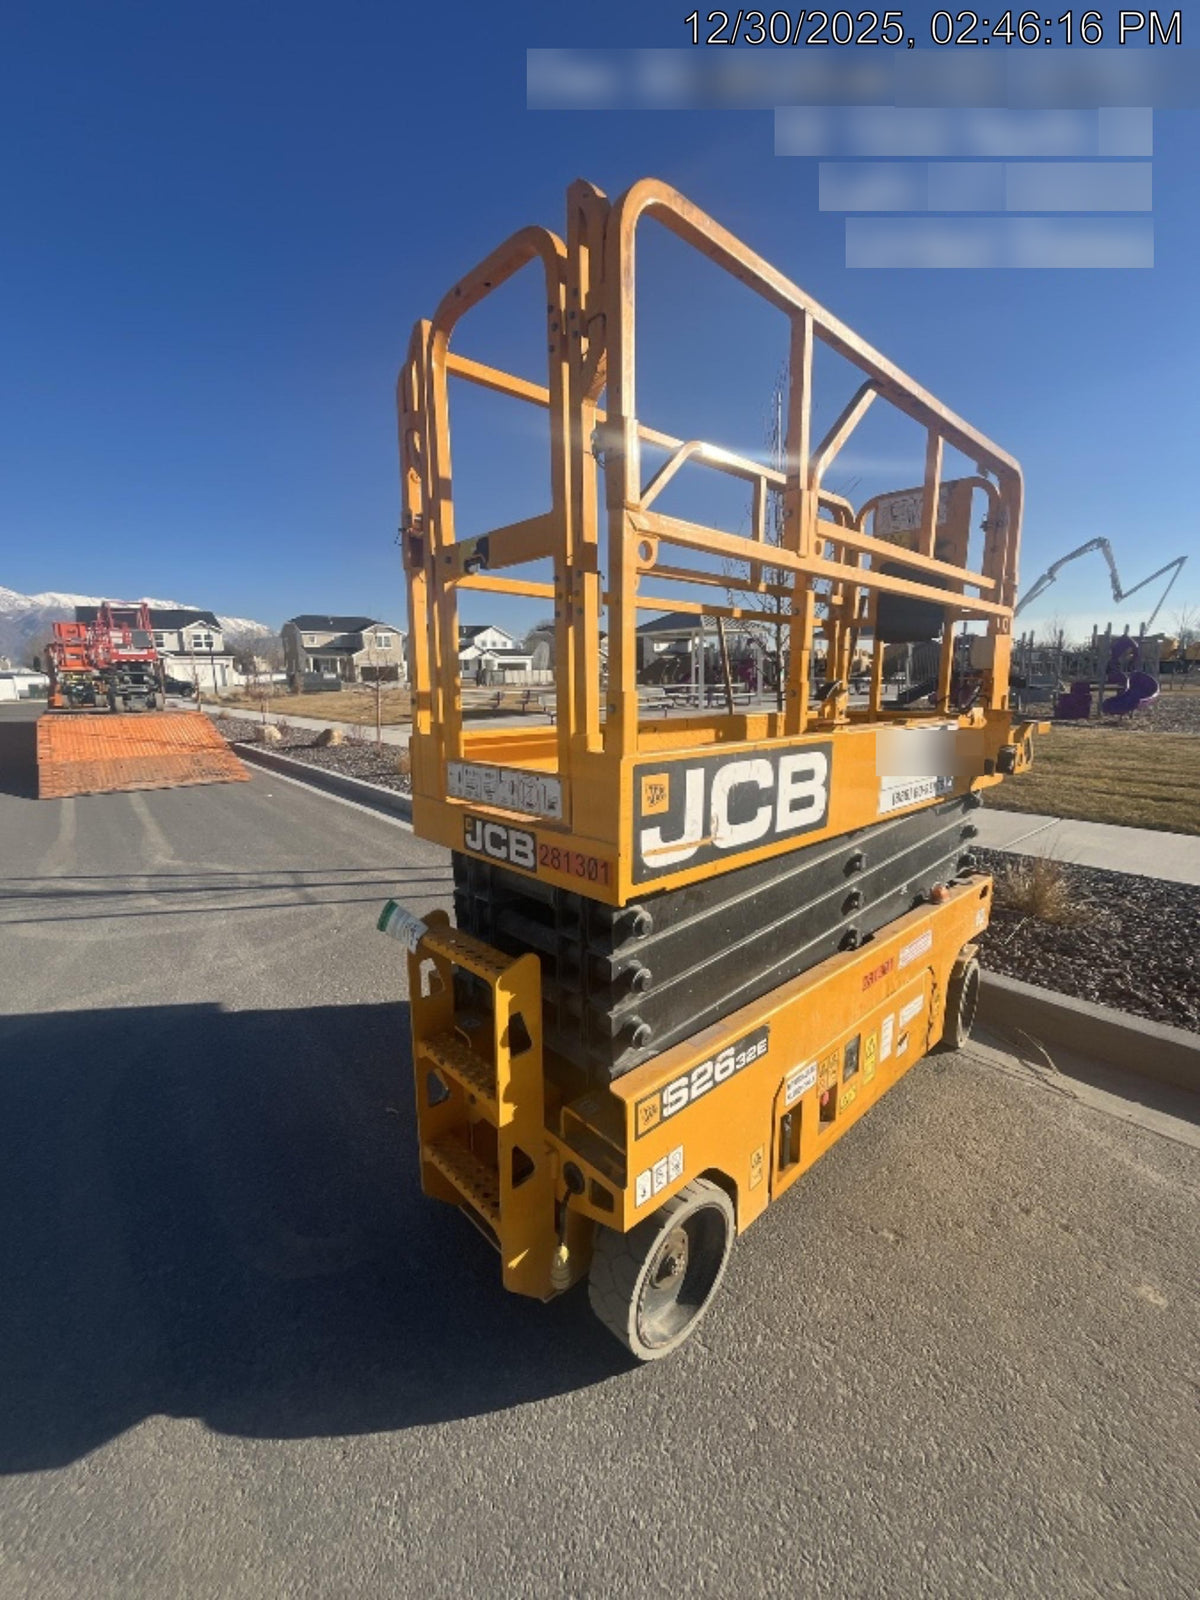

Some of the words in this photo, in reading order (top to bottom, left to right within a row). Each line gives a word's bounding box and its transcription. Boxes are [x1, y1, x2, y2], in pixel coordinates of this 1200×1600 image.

[640, 751, 828, 869] JCB
[465, 820, 535, 868] JCB
[539, 844, 610, 885] 281301
